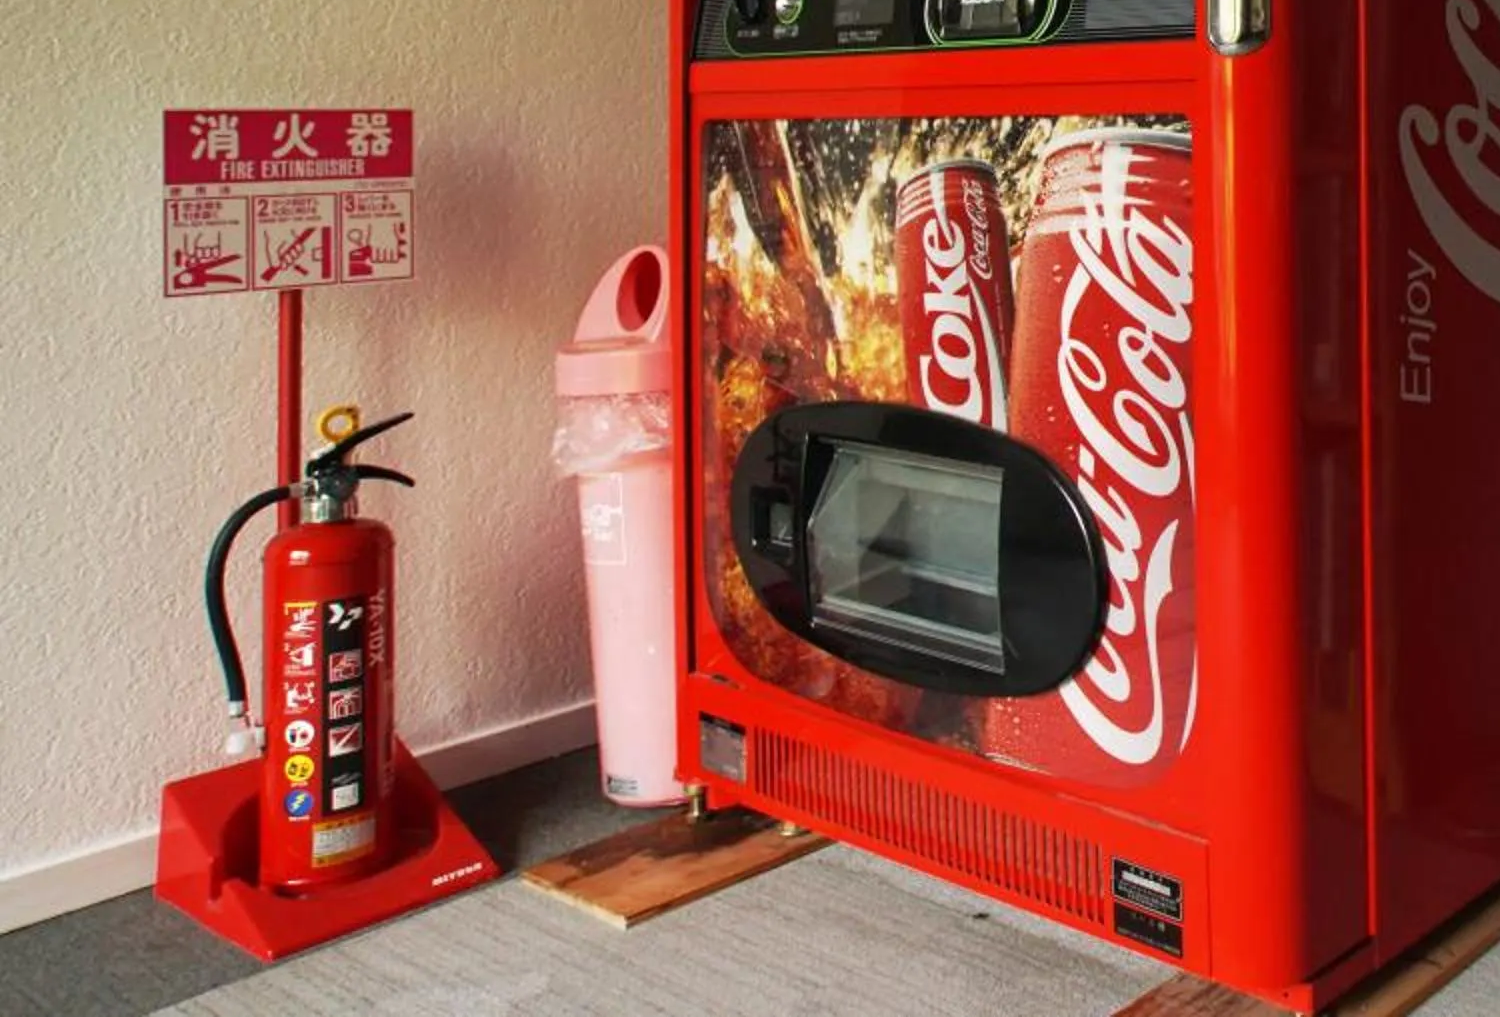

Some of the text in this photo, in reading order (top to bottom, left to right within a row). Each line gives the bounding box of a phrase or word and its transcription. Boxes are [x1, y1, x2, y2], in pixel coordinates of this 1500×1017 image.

[189, 113, 393, 160] 消火器
[220, 157, 366, 181] FIRE EXTINGUISHER
[257, 199, 270, 218] 2
[344, 195, 355, 213] 3
[962, 176, 993, 281] Coca-Cola
[919, 220, 984, 426] Coke
[1401, 249, 1437, 405] Enjoy
